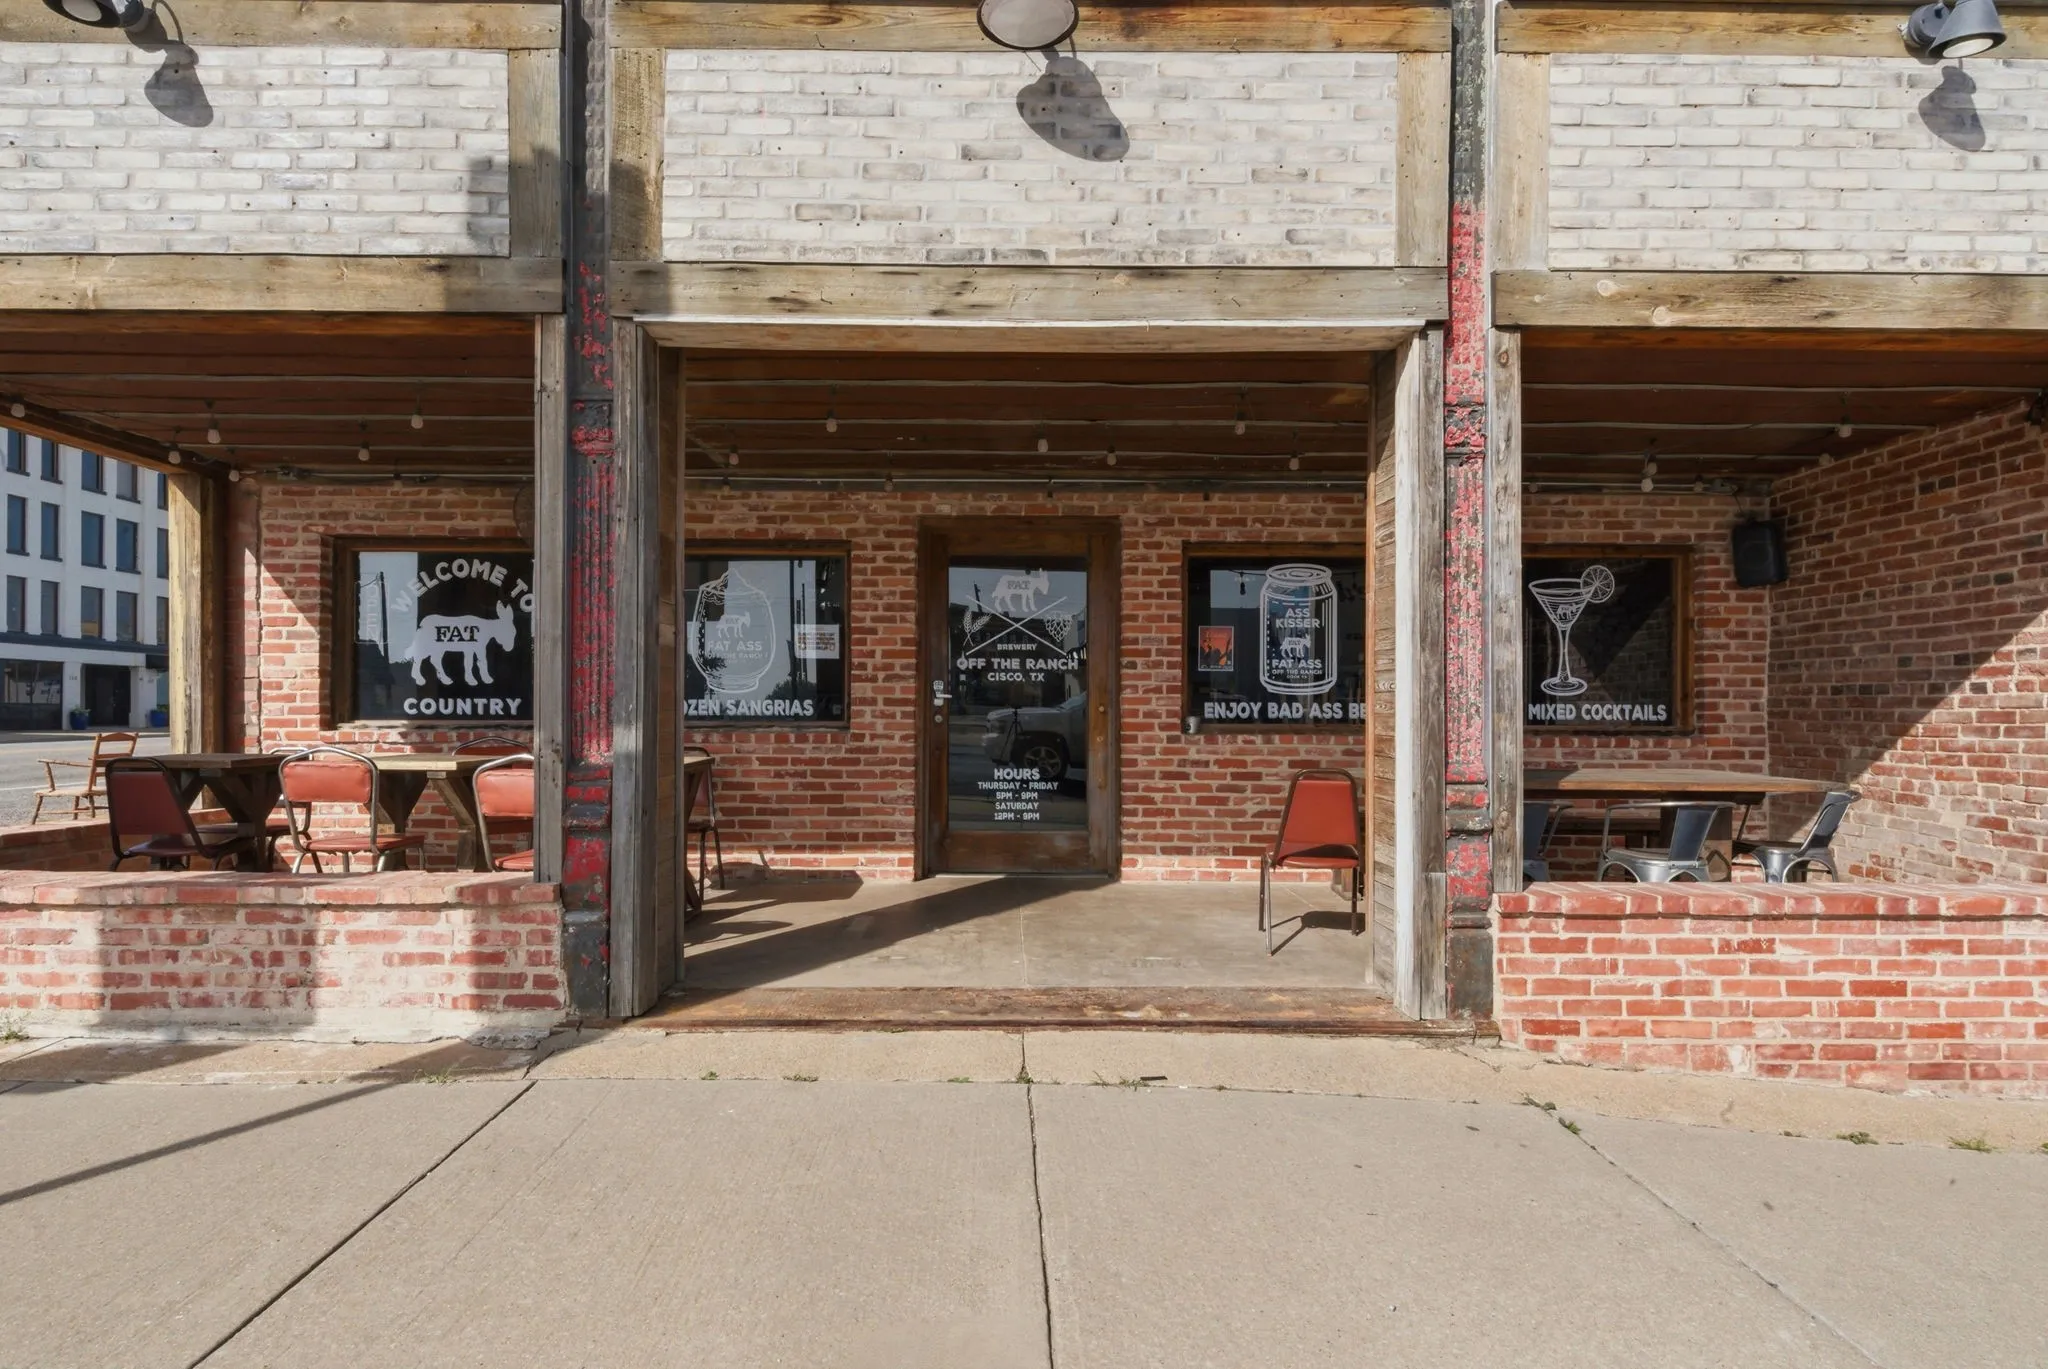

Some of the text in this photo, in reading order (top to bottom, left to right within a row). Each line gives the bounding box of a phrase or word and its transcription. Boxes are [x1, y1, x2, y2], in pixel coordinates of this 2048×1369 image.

[390, 558, 536, 613] WELCOME TO
[1007, 580, 1031, 590] FAT
[1285, 608, 1310, 618] ASS
[1275, 618, 1320, 628] KISSER
[435, 626, 480, 642] FAT
[708, 640, 762, 651] FAT ASS
[997, 643, 1037, 651] BREWERY
[957, 658, 1079, 671] OFF THE RANCH
[1272, 659, 1322, 669] FAT ASS
[988, 672, 1044, 681] CISCO, TX
[403, 698, 522, 715] COUNTRY
[726, 699, 814, 716] SANGRIAS
[1204, 702, 1262, 719] ENJOY
[1268, 702, 1303, 719] BAD
[1309, 702, 1343, 719] ASS
[1528, 703, 1667, 721] MIXED COCKTAILS
[994, 768, 1040, 780] HOURS
[977, 782, 1020, 790] THURSDAY
[1029, 782, 1058, 790] FRIDAY
[1021, 791, 1038, 799] 9PM
[995, 802, 1039, 810] SATURDAY
[994, 812, 1014, 820] 12PM
[1023, 812, 1040, 820] 9PM
